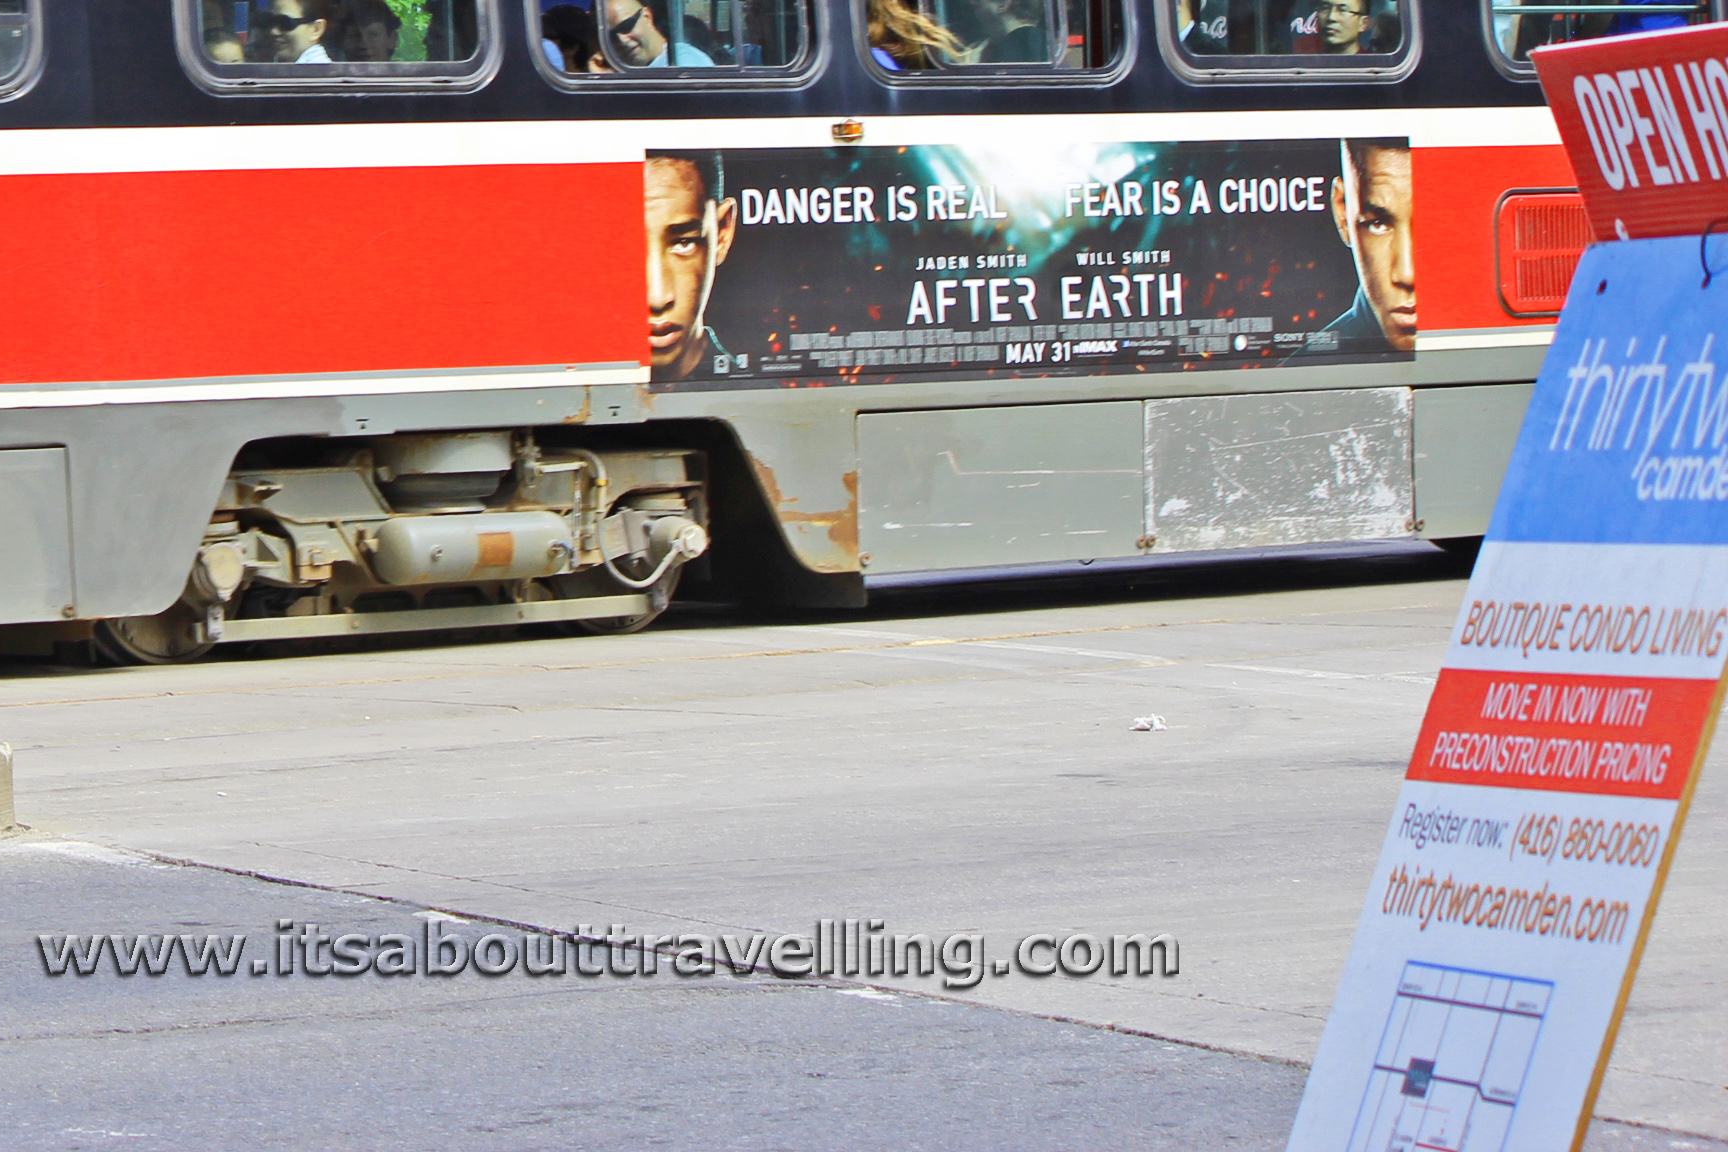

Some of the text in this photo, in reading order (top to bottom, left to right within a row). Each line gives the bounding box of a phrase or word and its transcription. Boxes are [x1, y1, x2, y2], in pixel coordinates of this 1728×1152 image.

[1573, 67, 1700, 190] OPEN
[741, 184, 1008, 225] DANGER IS REAL
[1065, 176, 1325, 218] FEAR IS A CHOICE
[915, 253, 1028, 271] JADEN SMITH
[1076, 249, 1171, 266] WILL SMITH
[906, 272, 1184, 326] AFTER EARTH
[1005, 341, 1046, 365] MAY
[1050, 341, 1071, 363] 31
[1460, 600, 1726, 658] BOUTIQUE CONDO LIVING
[1480, 682, 1653, 727] MOVE IN NOW WITH
[1429, 731, 1671, 785] PRECONSTRUCTION PRICING
[1398, 802, 1468, 850] Register
[1509, 812, 1563, 866] (416)
[1562, 817, 1660, 867] 860-0060
[1382, 862, 1629, 946] thirtytwocamden.com
